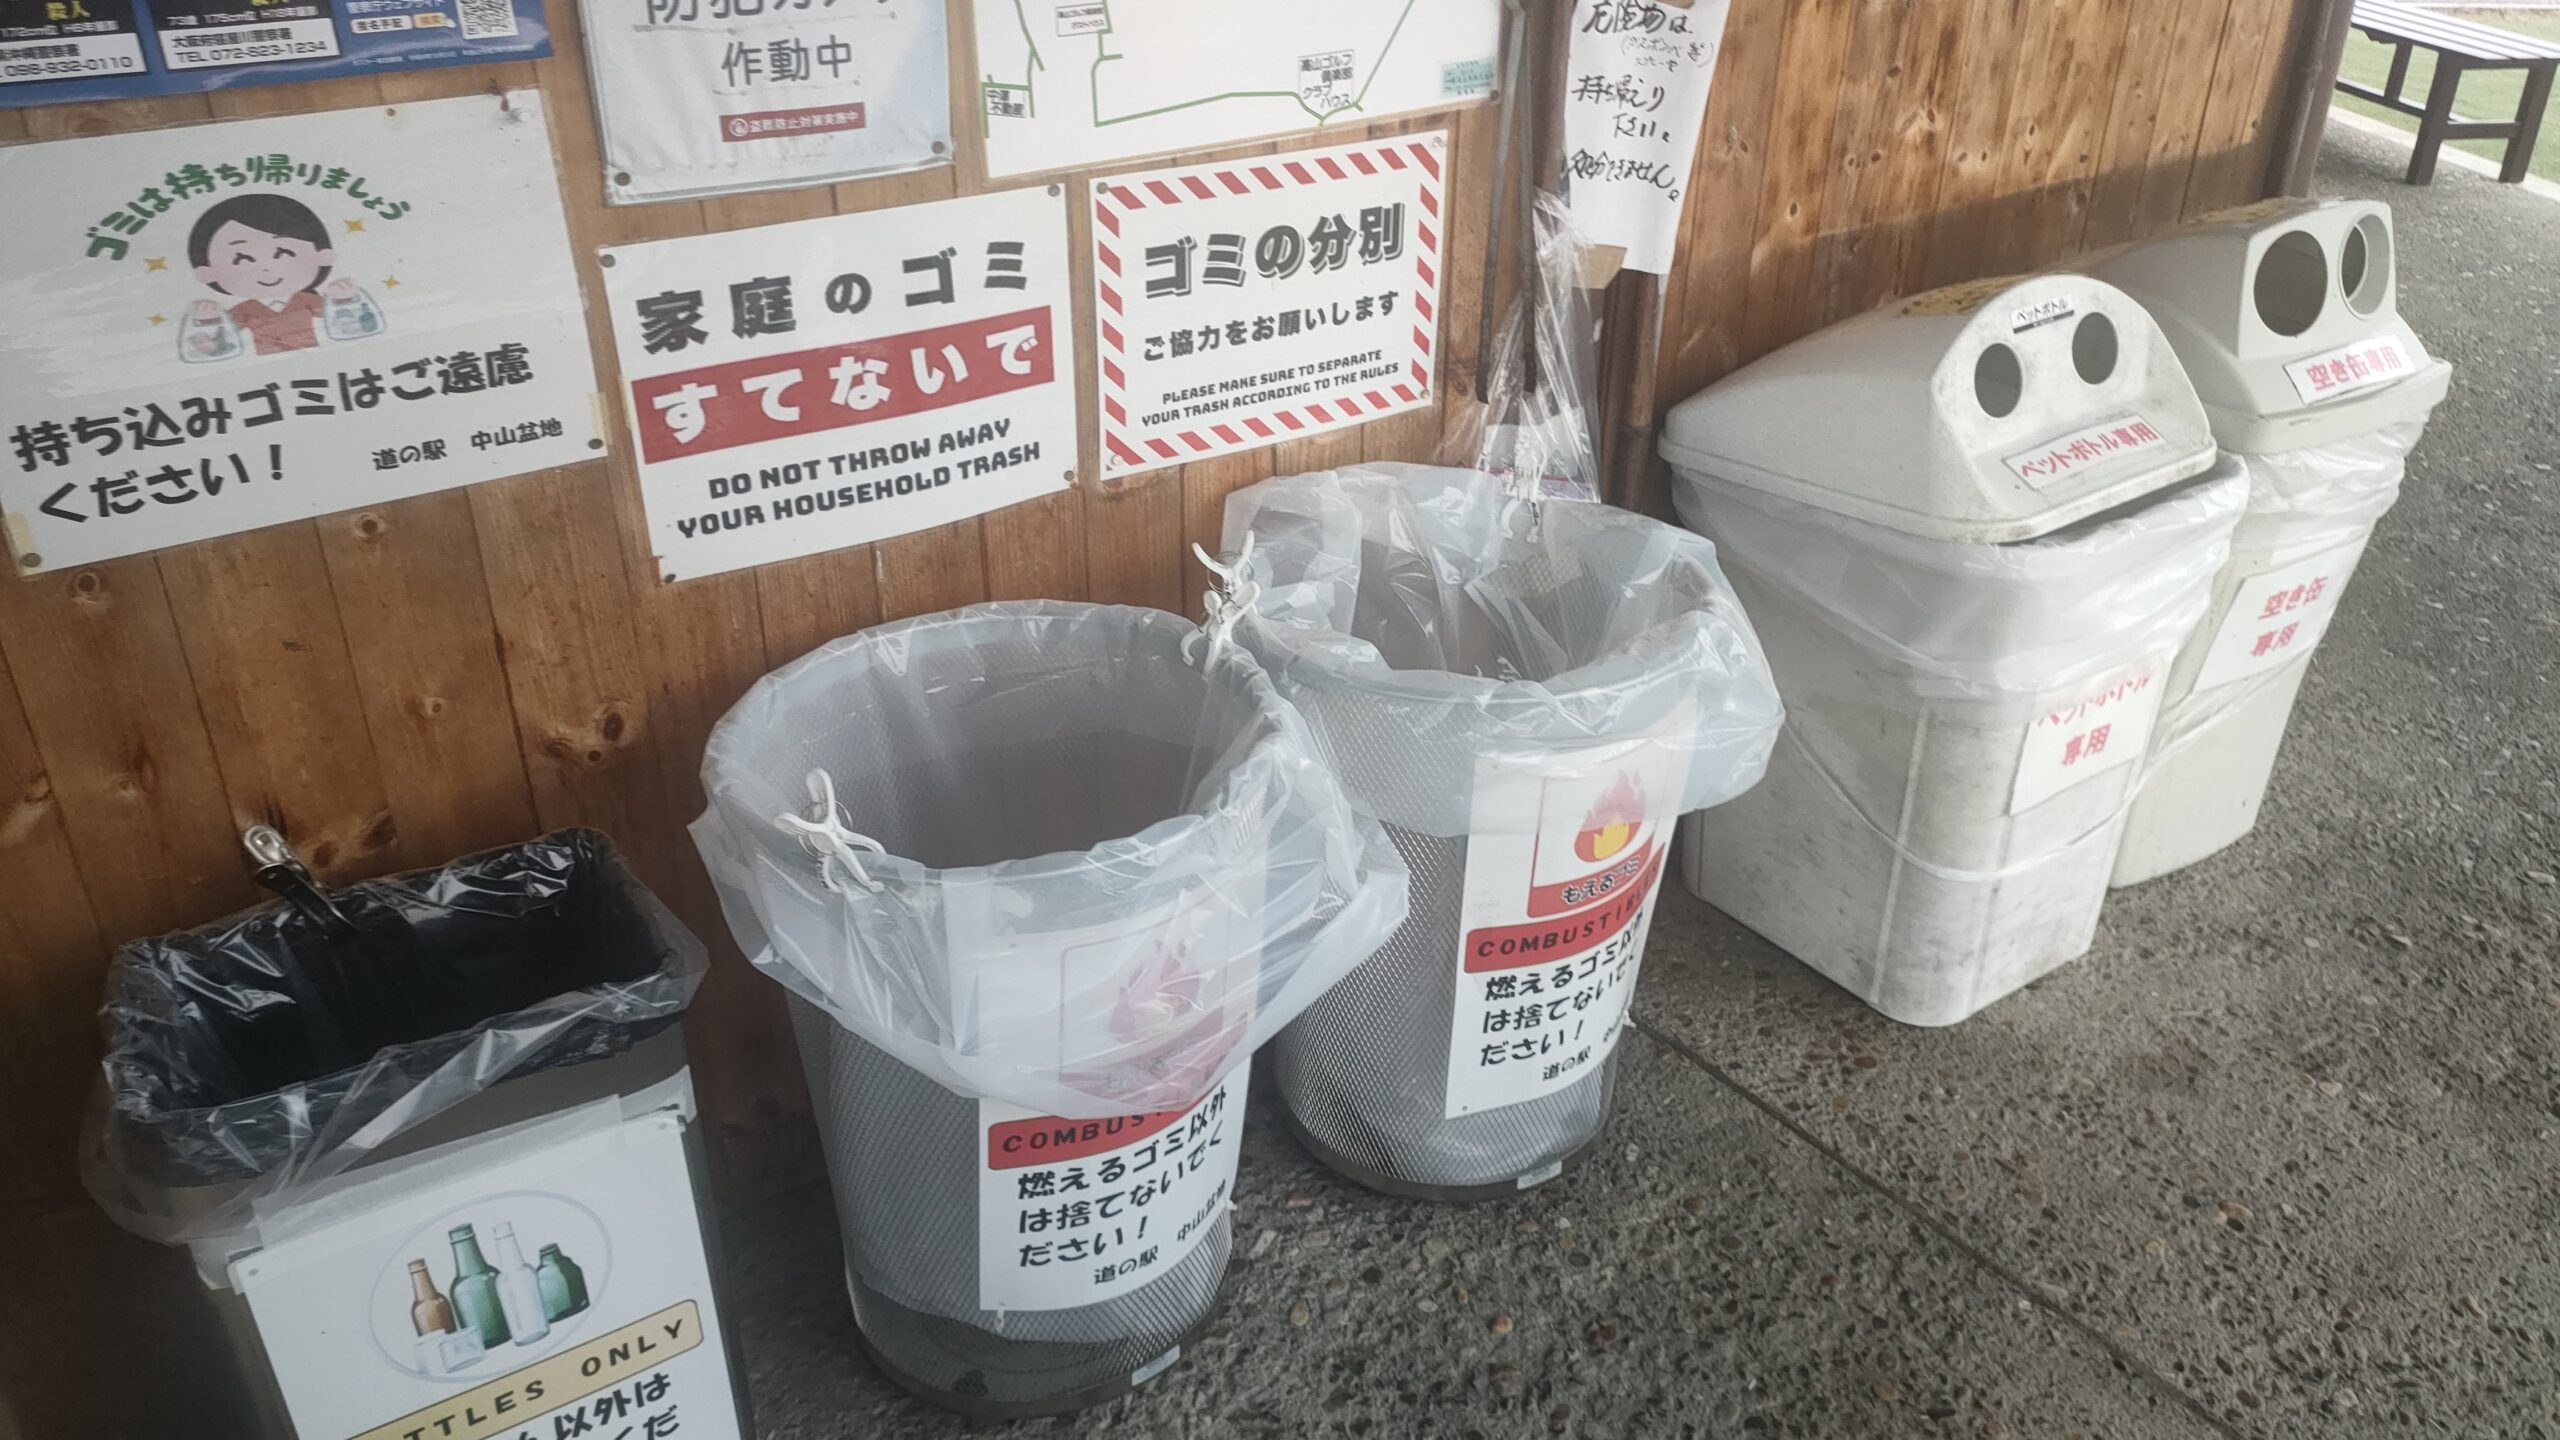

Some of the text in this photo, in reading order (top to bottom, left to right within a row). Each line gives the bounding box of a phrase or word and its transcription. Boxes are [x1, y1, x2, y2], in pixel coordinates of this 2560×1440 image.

[4, 57, 133, 76] 098-932-0110
[175, 41, 327, 63] TEL 072-823-1234
[721, 34, 851, 87] 作動中
[86, 153, 412, 261] ゴミは持ち帰りましょう
[1145, 202, 1405, 299] ゴミの分別
[636, 242, 1027, 354] 家庭のゴミ
[1144, 291, 1399, 361] ご協力をお願いします
[652, 325, 1038, 444] すてないで
[1142, 362, 1399, 427] YOUR TRASH ACCORDING TO THE RULES
[1162, 350, 1382, 404] PLEASE MAKE SURE TO SEPARATE
[2306, 346, 2402, 392] 空き缶専用
[10, 343, 534, 472] 持ち込みゴミはご遠慮
[372, 418, 563, 471] 道の駅 中山盆地
[709, 418, 1010, 500] DO NOT THROW AWAY
[2021, 422, 2159, 477] ペットボトル専用
[678, 442, 1041, 538] YOUR HOUSEHOLD TRASH
[2258, 576, 2328, 620] 空き缶
[2249, 621, 2299, 657] 専用
[2061, 723, 2111, 767] 専用
[1018, 1085, 1226, 1200] 燃えるゴミ以外
[1019, 1120, 1222, 1233] は捨てないでく
[1094, 1245, 1159, 1285] 道の駅
[580, 1319, 683, 1378] ONLY
[519, 1372, 671, 1440] 以外は
